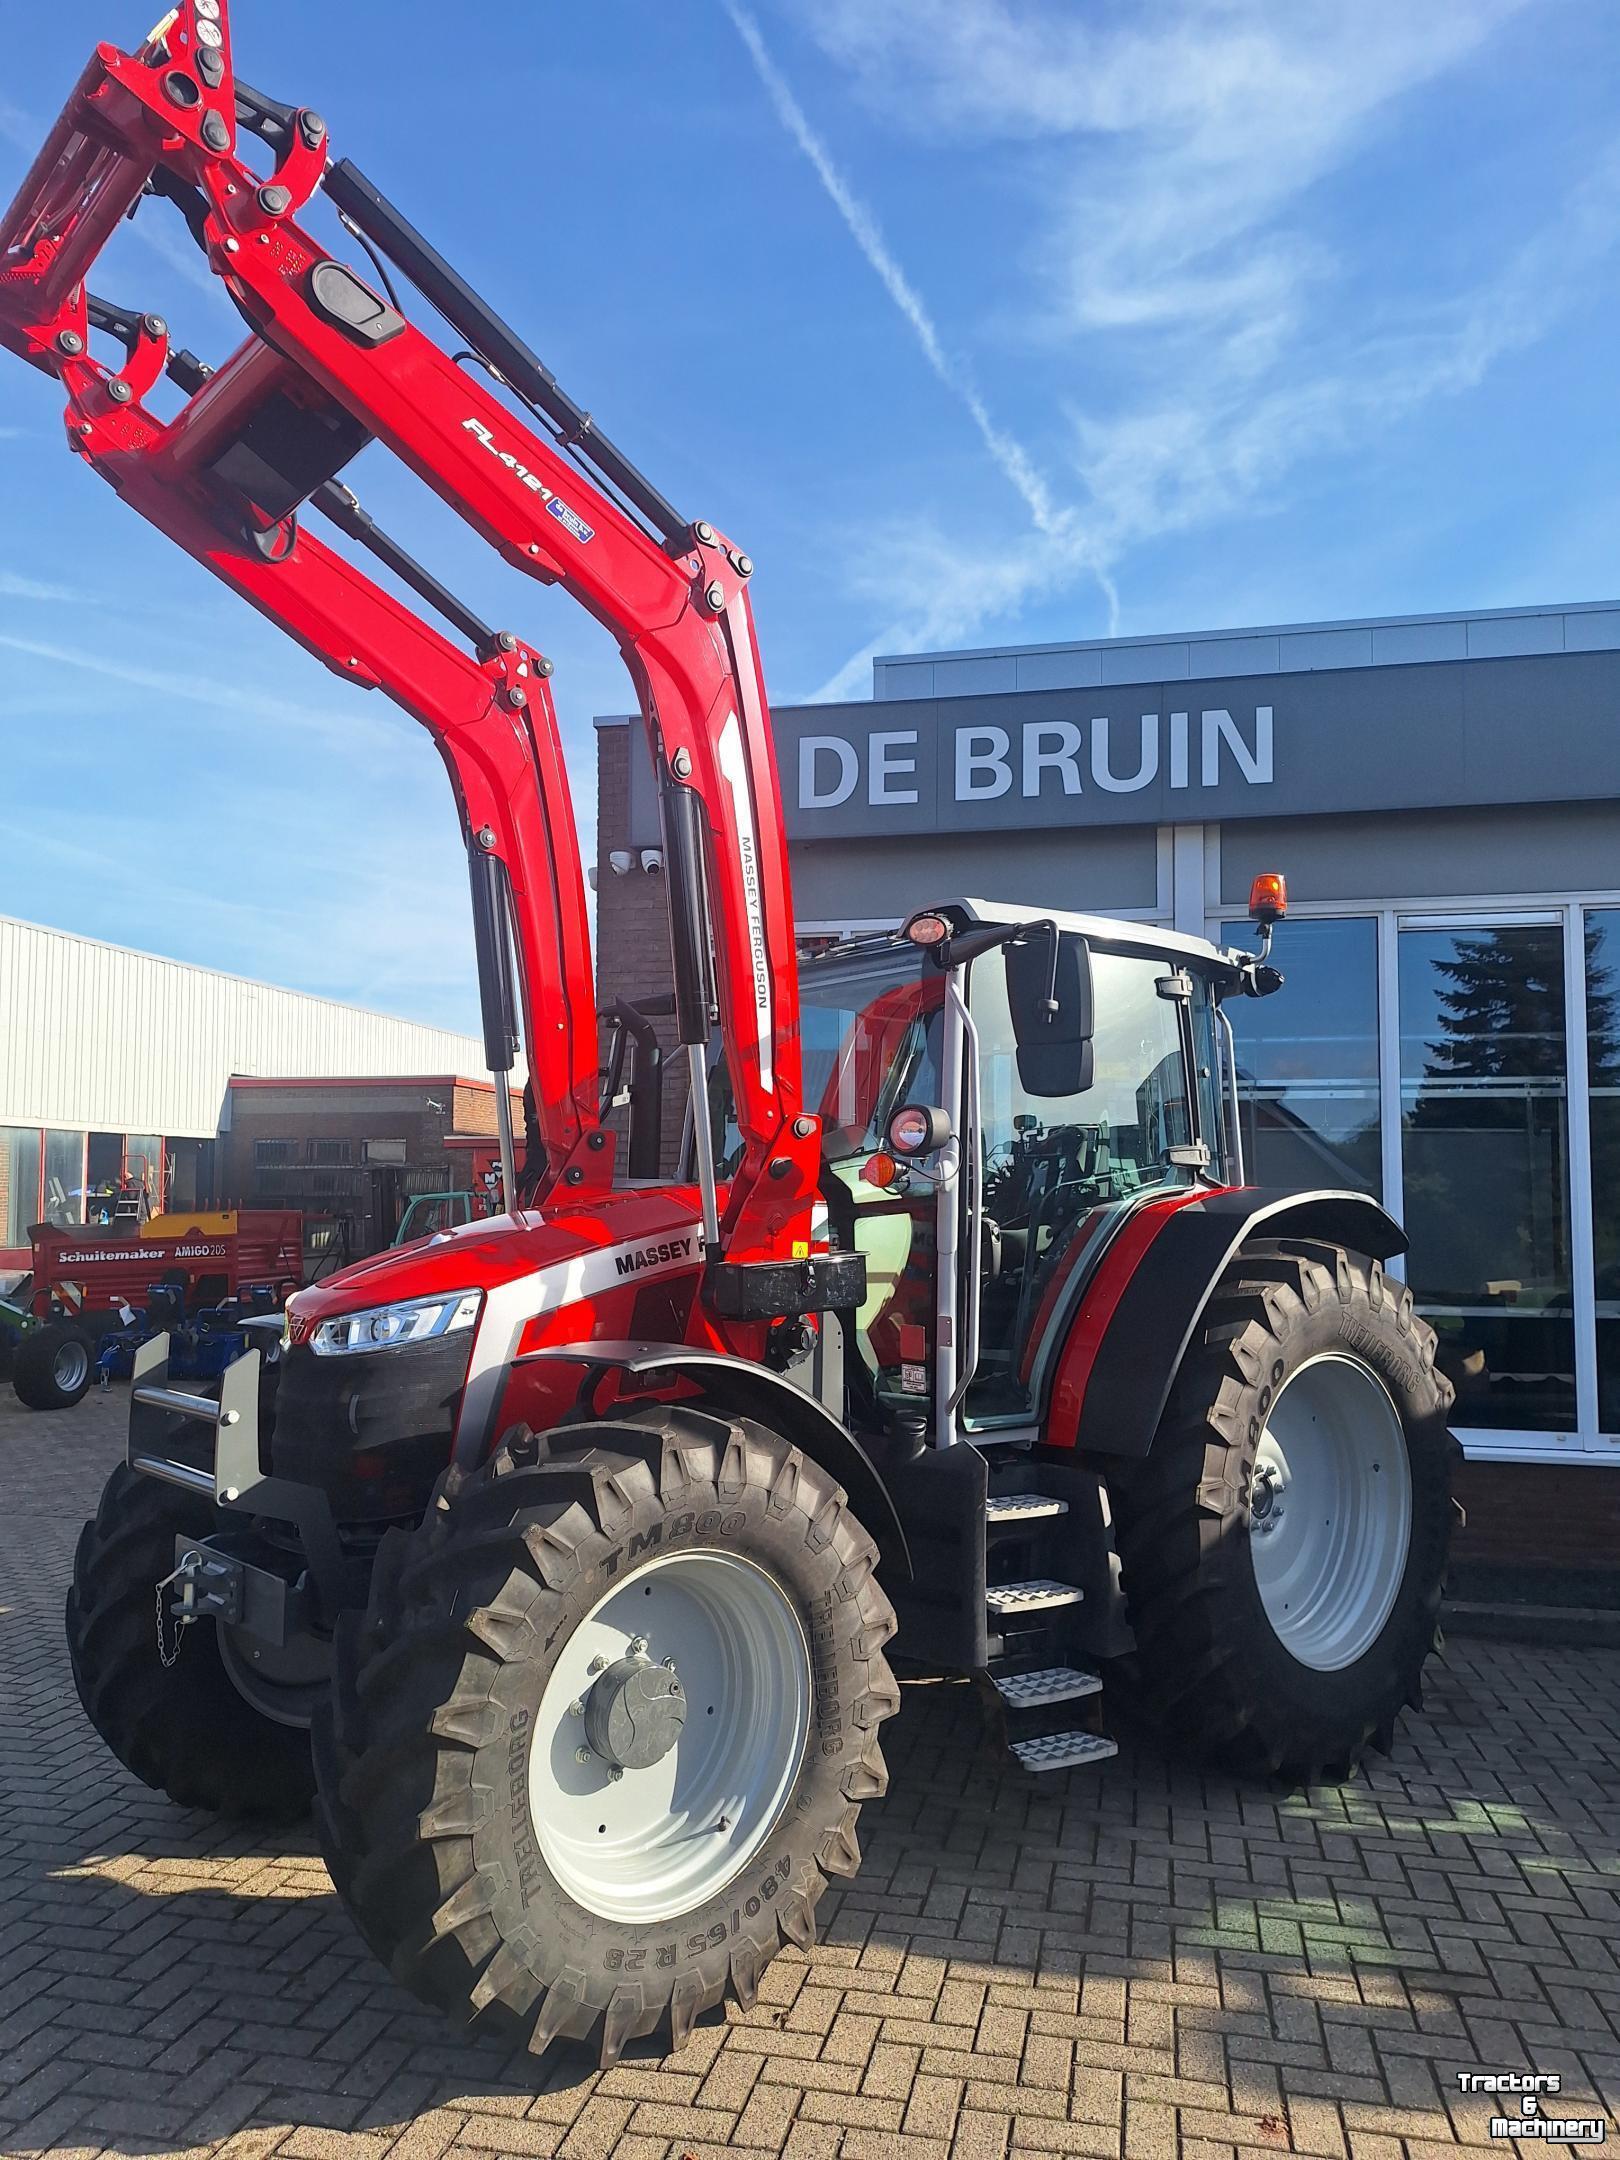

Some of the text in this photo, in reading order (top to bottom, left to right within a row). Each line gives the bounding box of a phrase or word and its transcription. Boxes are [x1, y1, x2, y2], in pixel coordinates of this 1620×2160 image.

[798, 705, 1274, 810] DE BRUIN
[741, 836, 768, 1009] MASSEY FERGUSON
[58, 1248, 166, 1264] Schuitemaker
[174, 1245, 210, 1258] AMIGO
[615, 1238, 691, 1275] MASSEY
[1337, 1311, 1420, 1394] TRELLEBORG
[809, 1588, 844, 1757] TRELLEBORG
[508, 1708, 541, 1911] TRELLEBORG
